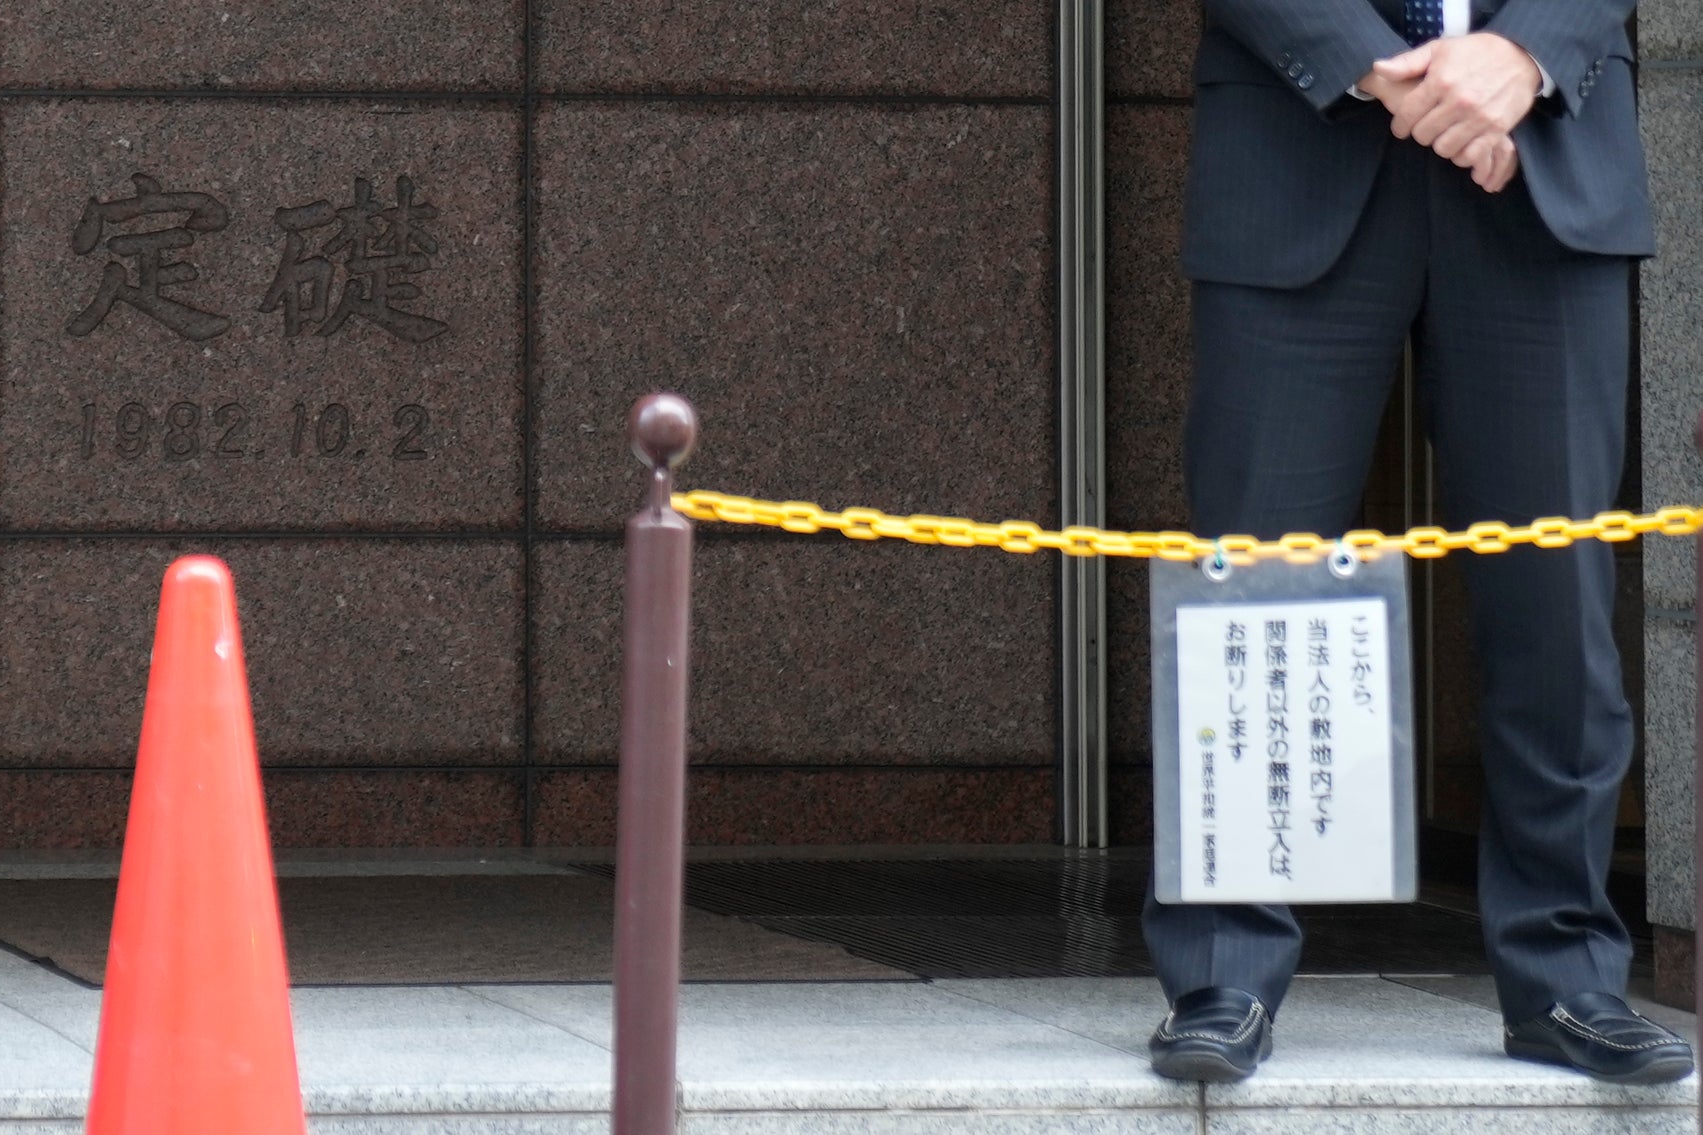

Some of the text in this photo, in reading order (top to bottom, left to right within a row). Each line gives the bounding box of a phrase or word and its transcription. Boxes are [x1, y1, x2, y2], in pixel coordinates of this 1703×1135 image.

[65, 171, 449, 341] 定礎
[1224, 620, 1248, 762] お断りします
[1307, 617, 1334, 838] 当法人の敷地内です
